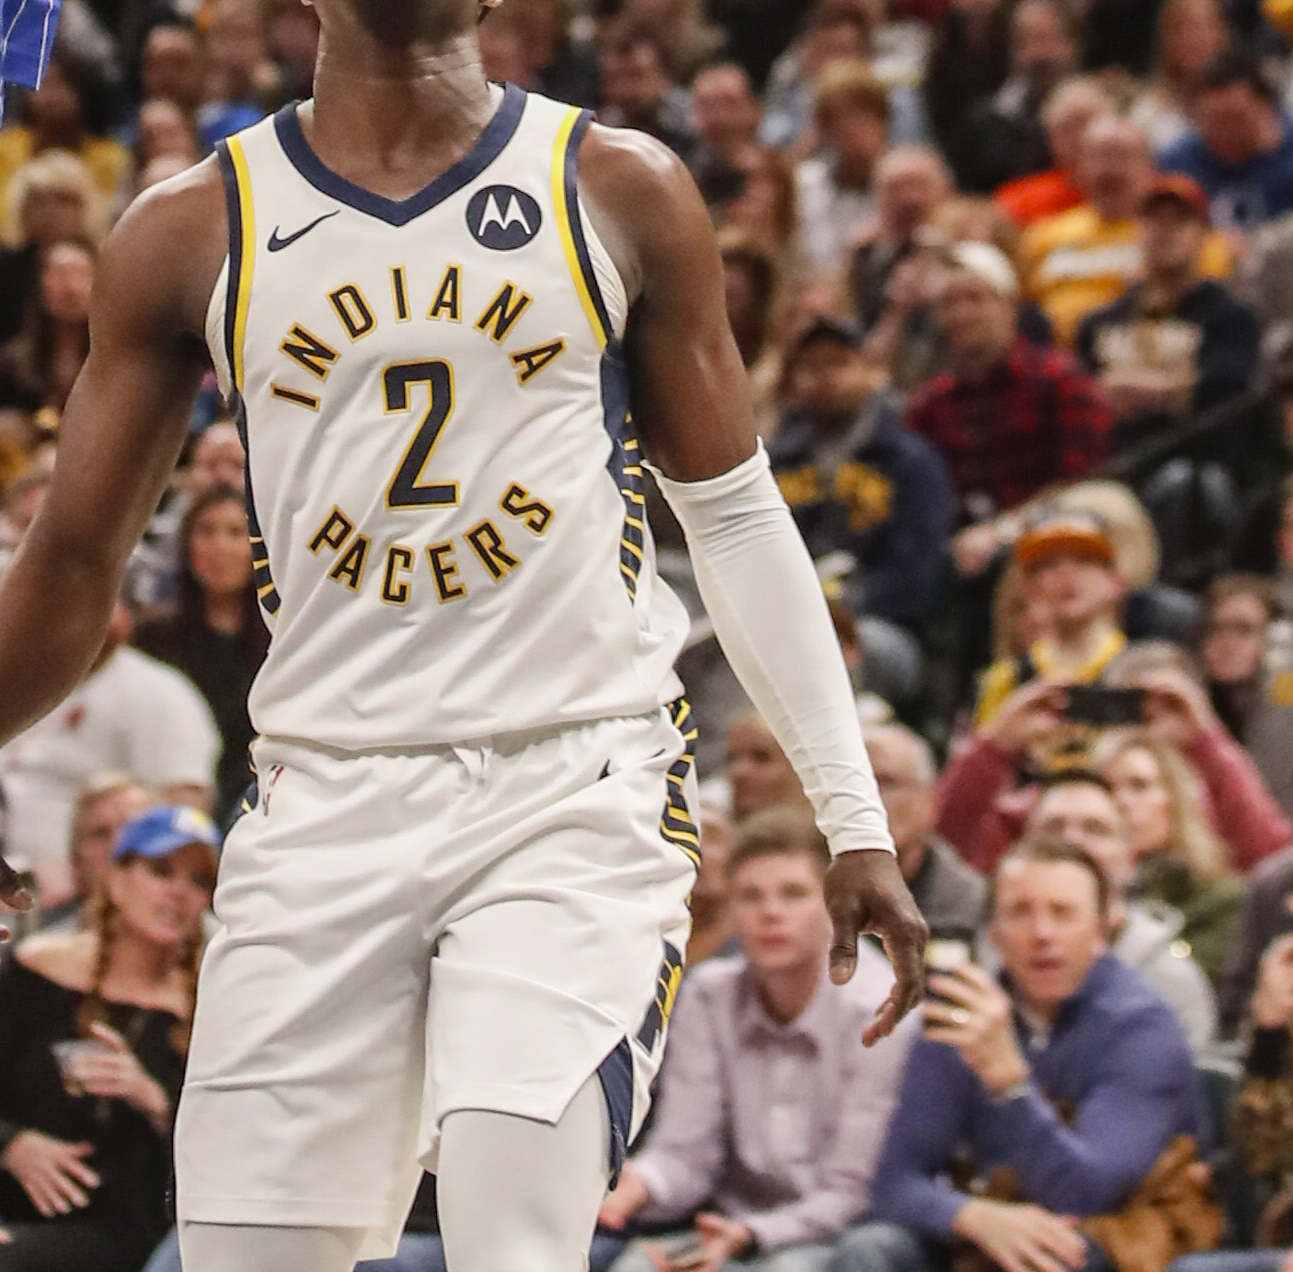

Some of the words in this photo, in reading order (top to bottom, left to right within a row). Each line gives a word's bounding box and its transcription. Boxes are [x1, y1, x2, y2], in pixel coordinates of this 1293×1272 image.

[270, 262, 567, 413] INDIANA
[382, 355, 461, 513] 2
[308, 480, 556, 606] PACERS
